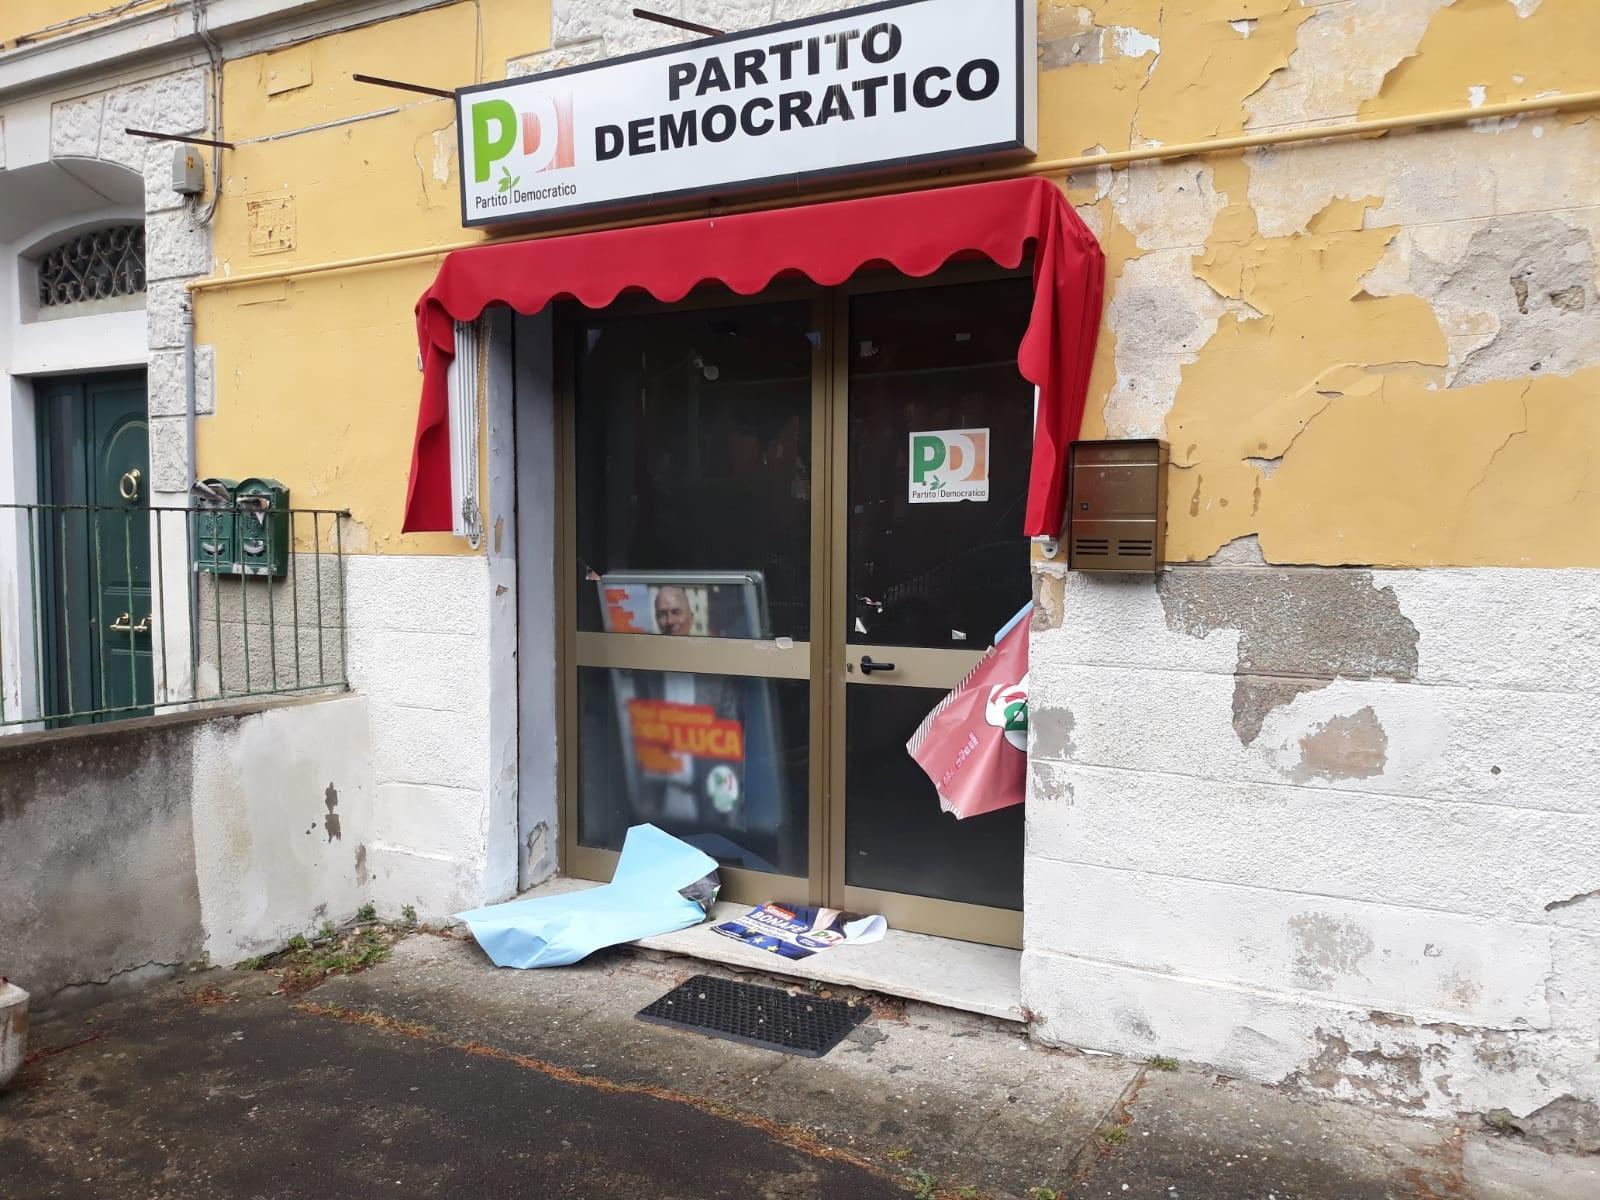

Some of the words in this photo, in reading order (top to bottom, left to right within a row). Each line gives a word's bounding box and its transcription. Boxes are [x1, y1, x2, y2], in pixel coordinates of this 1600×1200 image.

[668, 22, 902, 100] PARTITO
[594, 58, 1000, 161] DEMOCRATICO
[475, 194, 508, 209] Partito
[513, 182, 577, 204] Democratico
[912, 490, 937, 499] Partito
[940, 489, 986, 498] Democratico
[672, 727, 742, 755] LUCA
